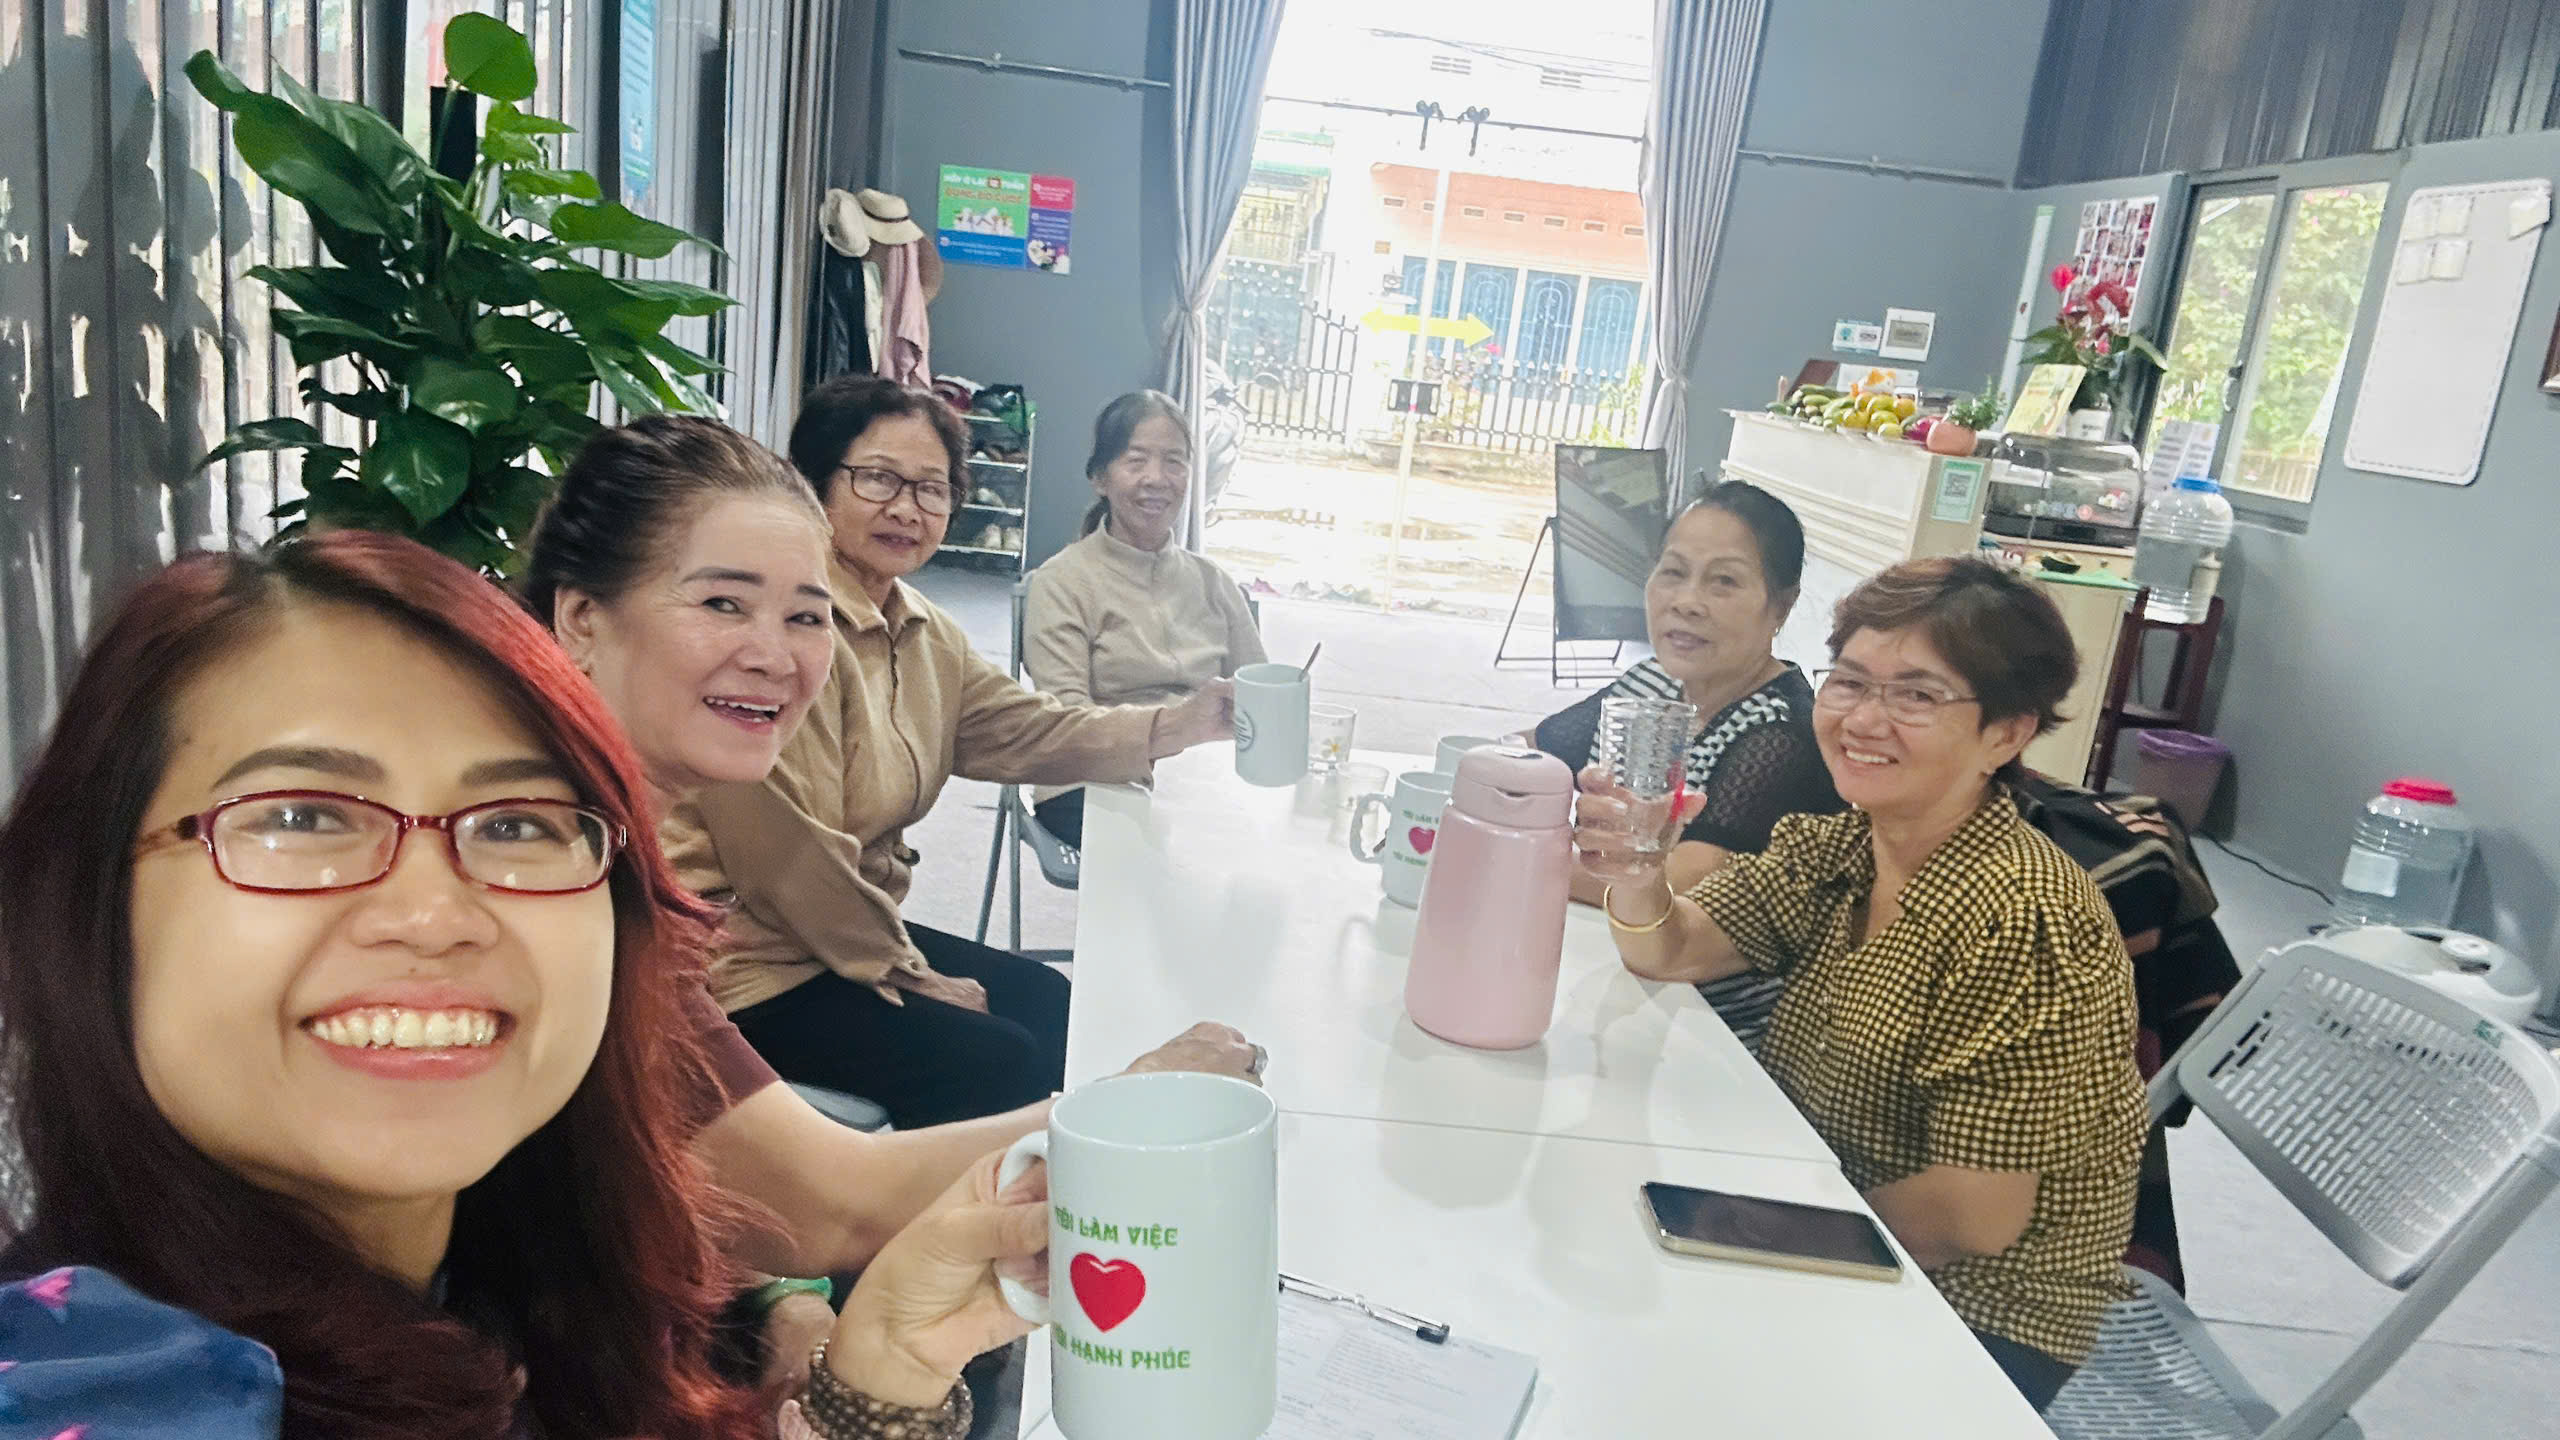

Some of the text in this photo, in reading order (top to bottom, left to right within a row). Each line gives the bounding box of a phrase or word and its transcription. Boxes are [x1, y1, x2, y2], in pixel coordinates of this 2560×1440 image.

[1079, 1216, 1119, 1243] LÀM
[1127, 1223, 1178, 1250] VIỆC
[1070, 1336, 1123, 1367] HẠNH
[1131, 1347, 1191, 1369] PHÚC
